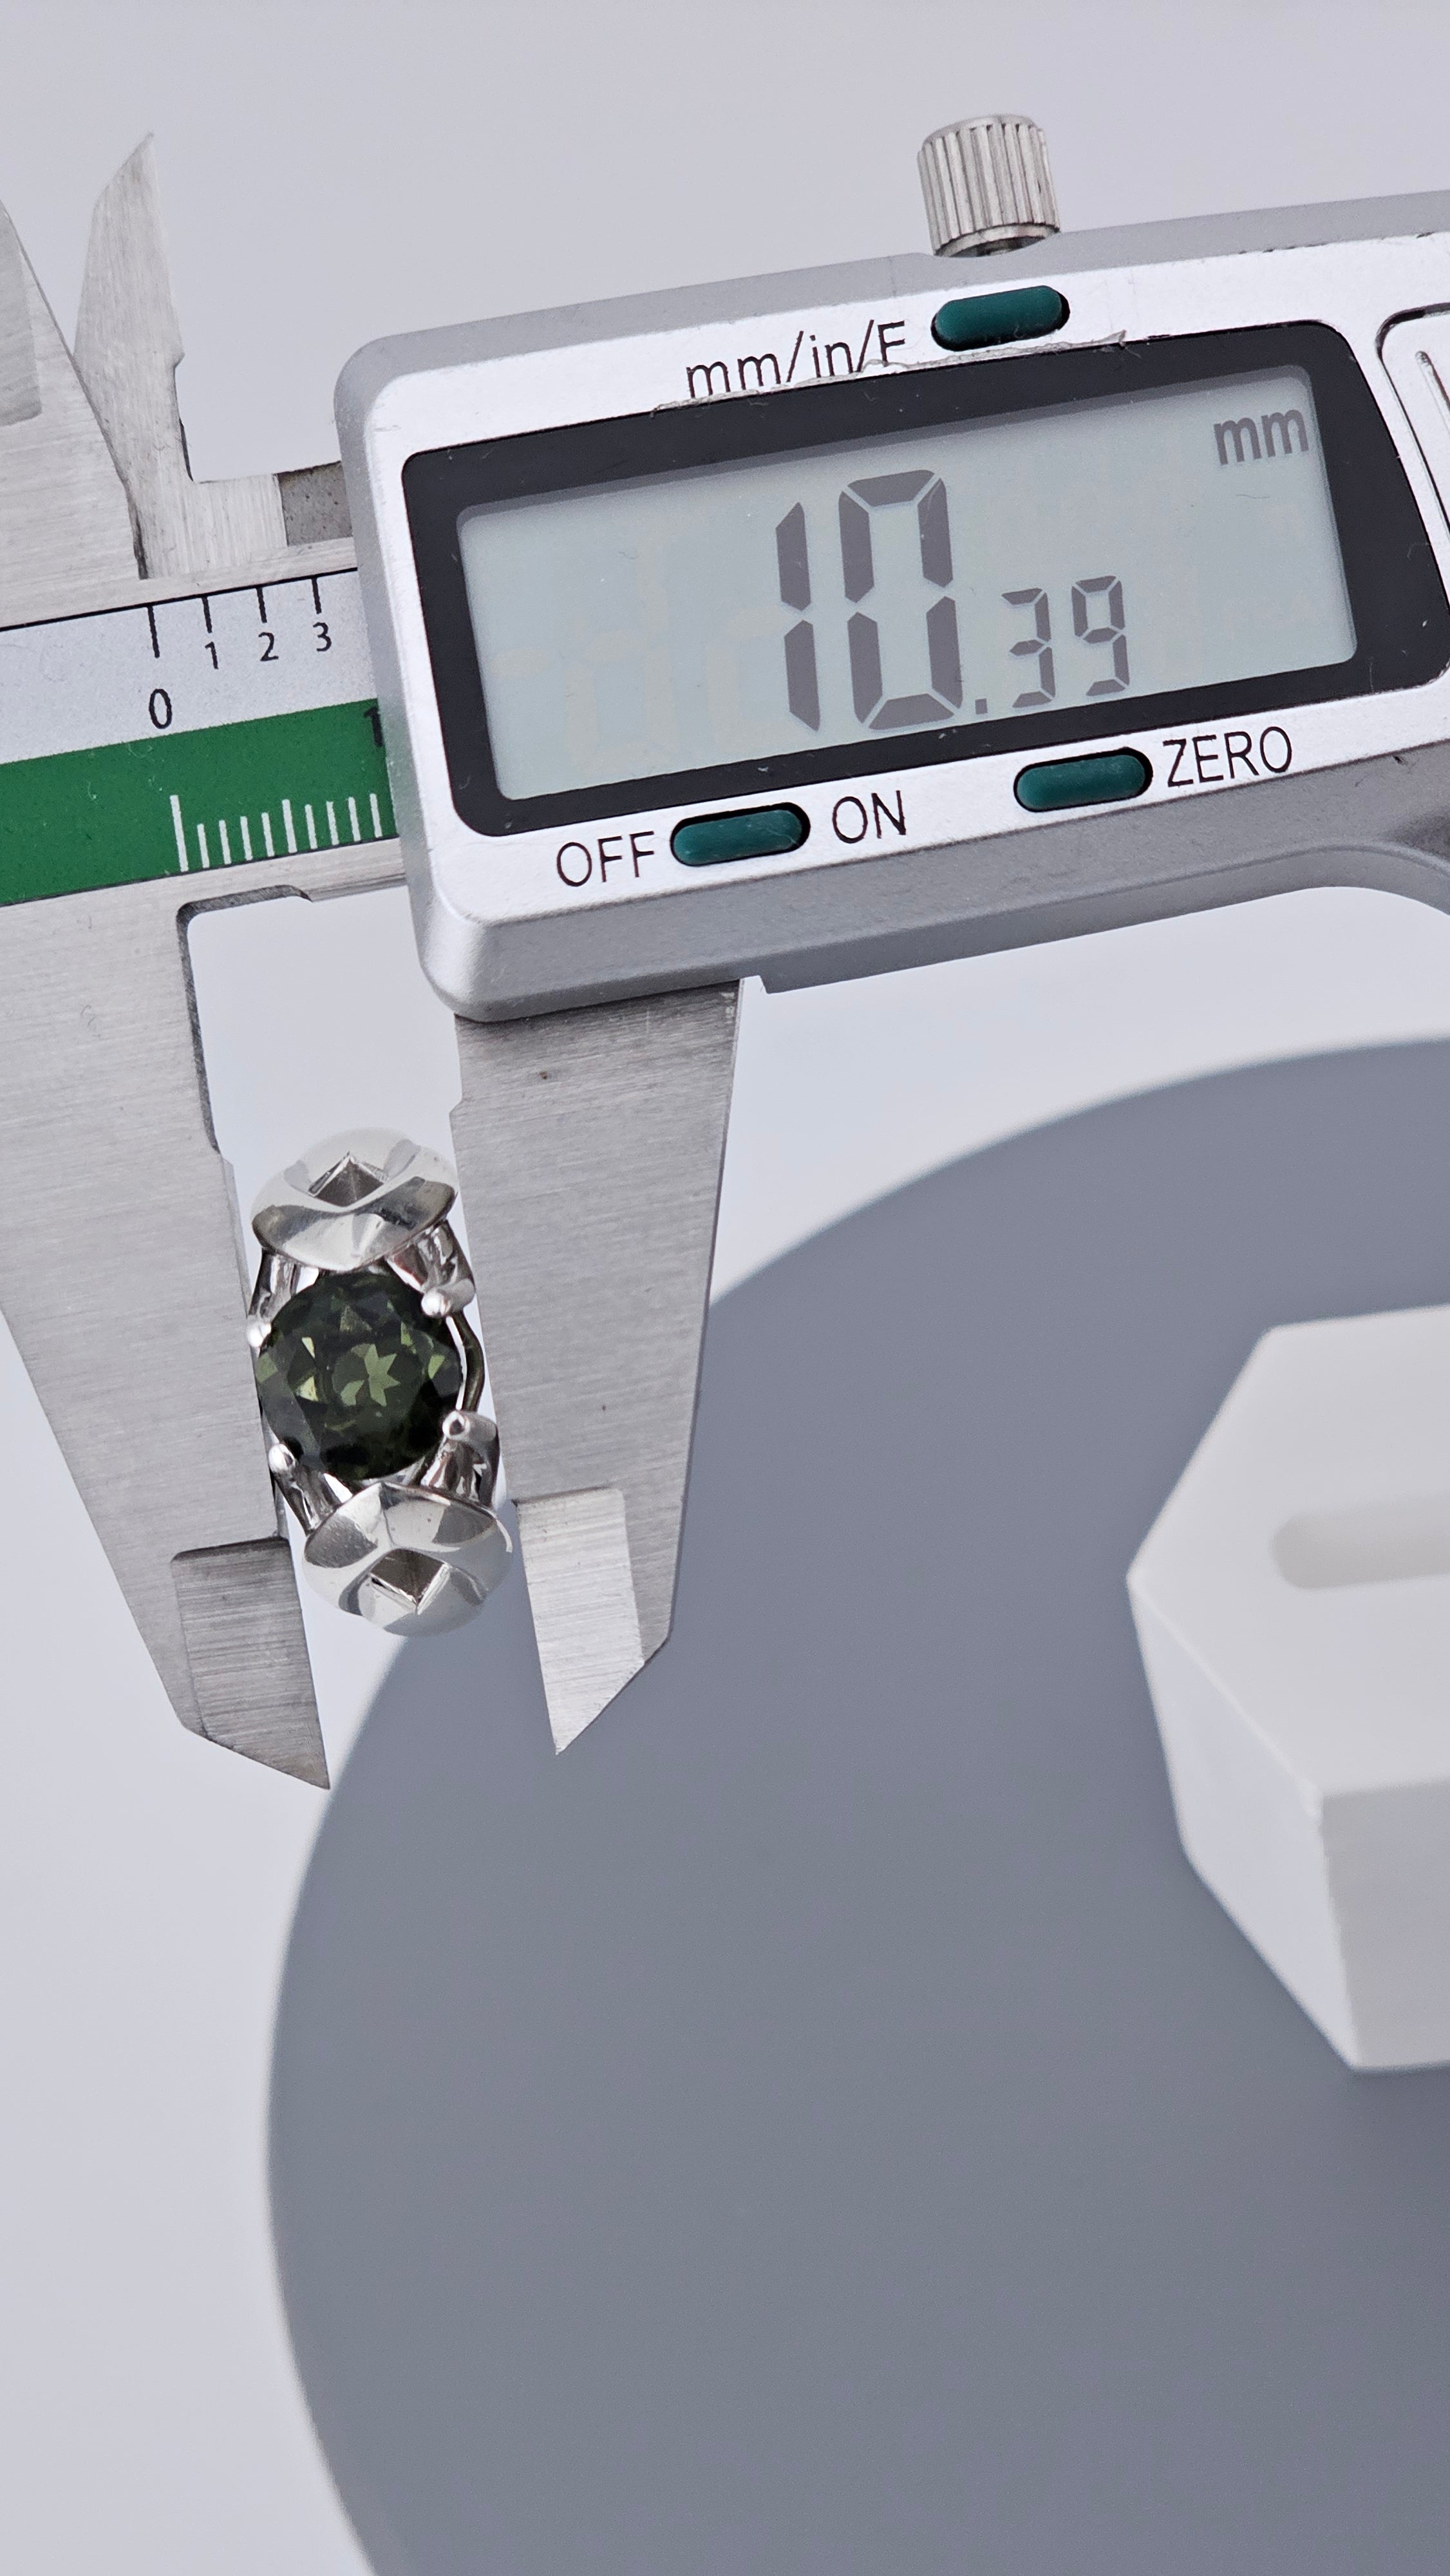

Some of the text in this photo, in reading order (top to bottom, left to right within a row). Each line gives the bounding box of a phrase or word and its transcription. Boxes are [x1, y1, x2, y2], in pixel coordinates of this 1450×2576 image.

[686, 319, 907, 399] mm/in/F
[1214, 408, 1310, 466] mm
[775, 469, 1131, 732] 10.39
[149, 622, 332, 729] 0 1 2 3
[1162, 726, 1293, 788] ZERO
[831, 790, 907, 844] ON
[556, 830, 655, 887] OFF
